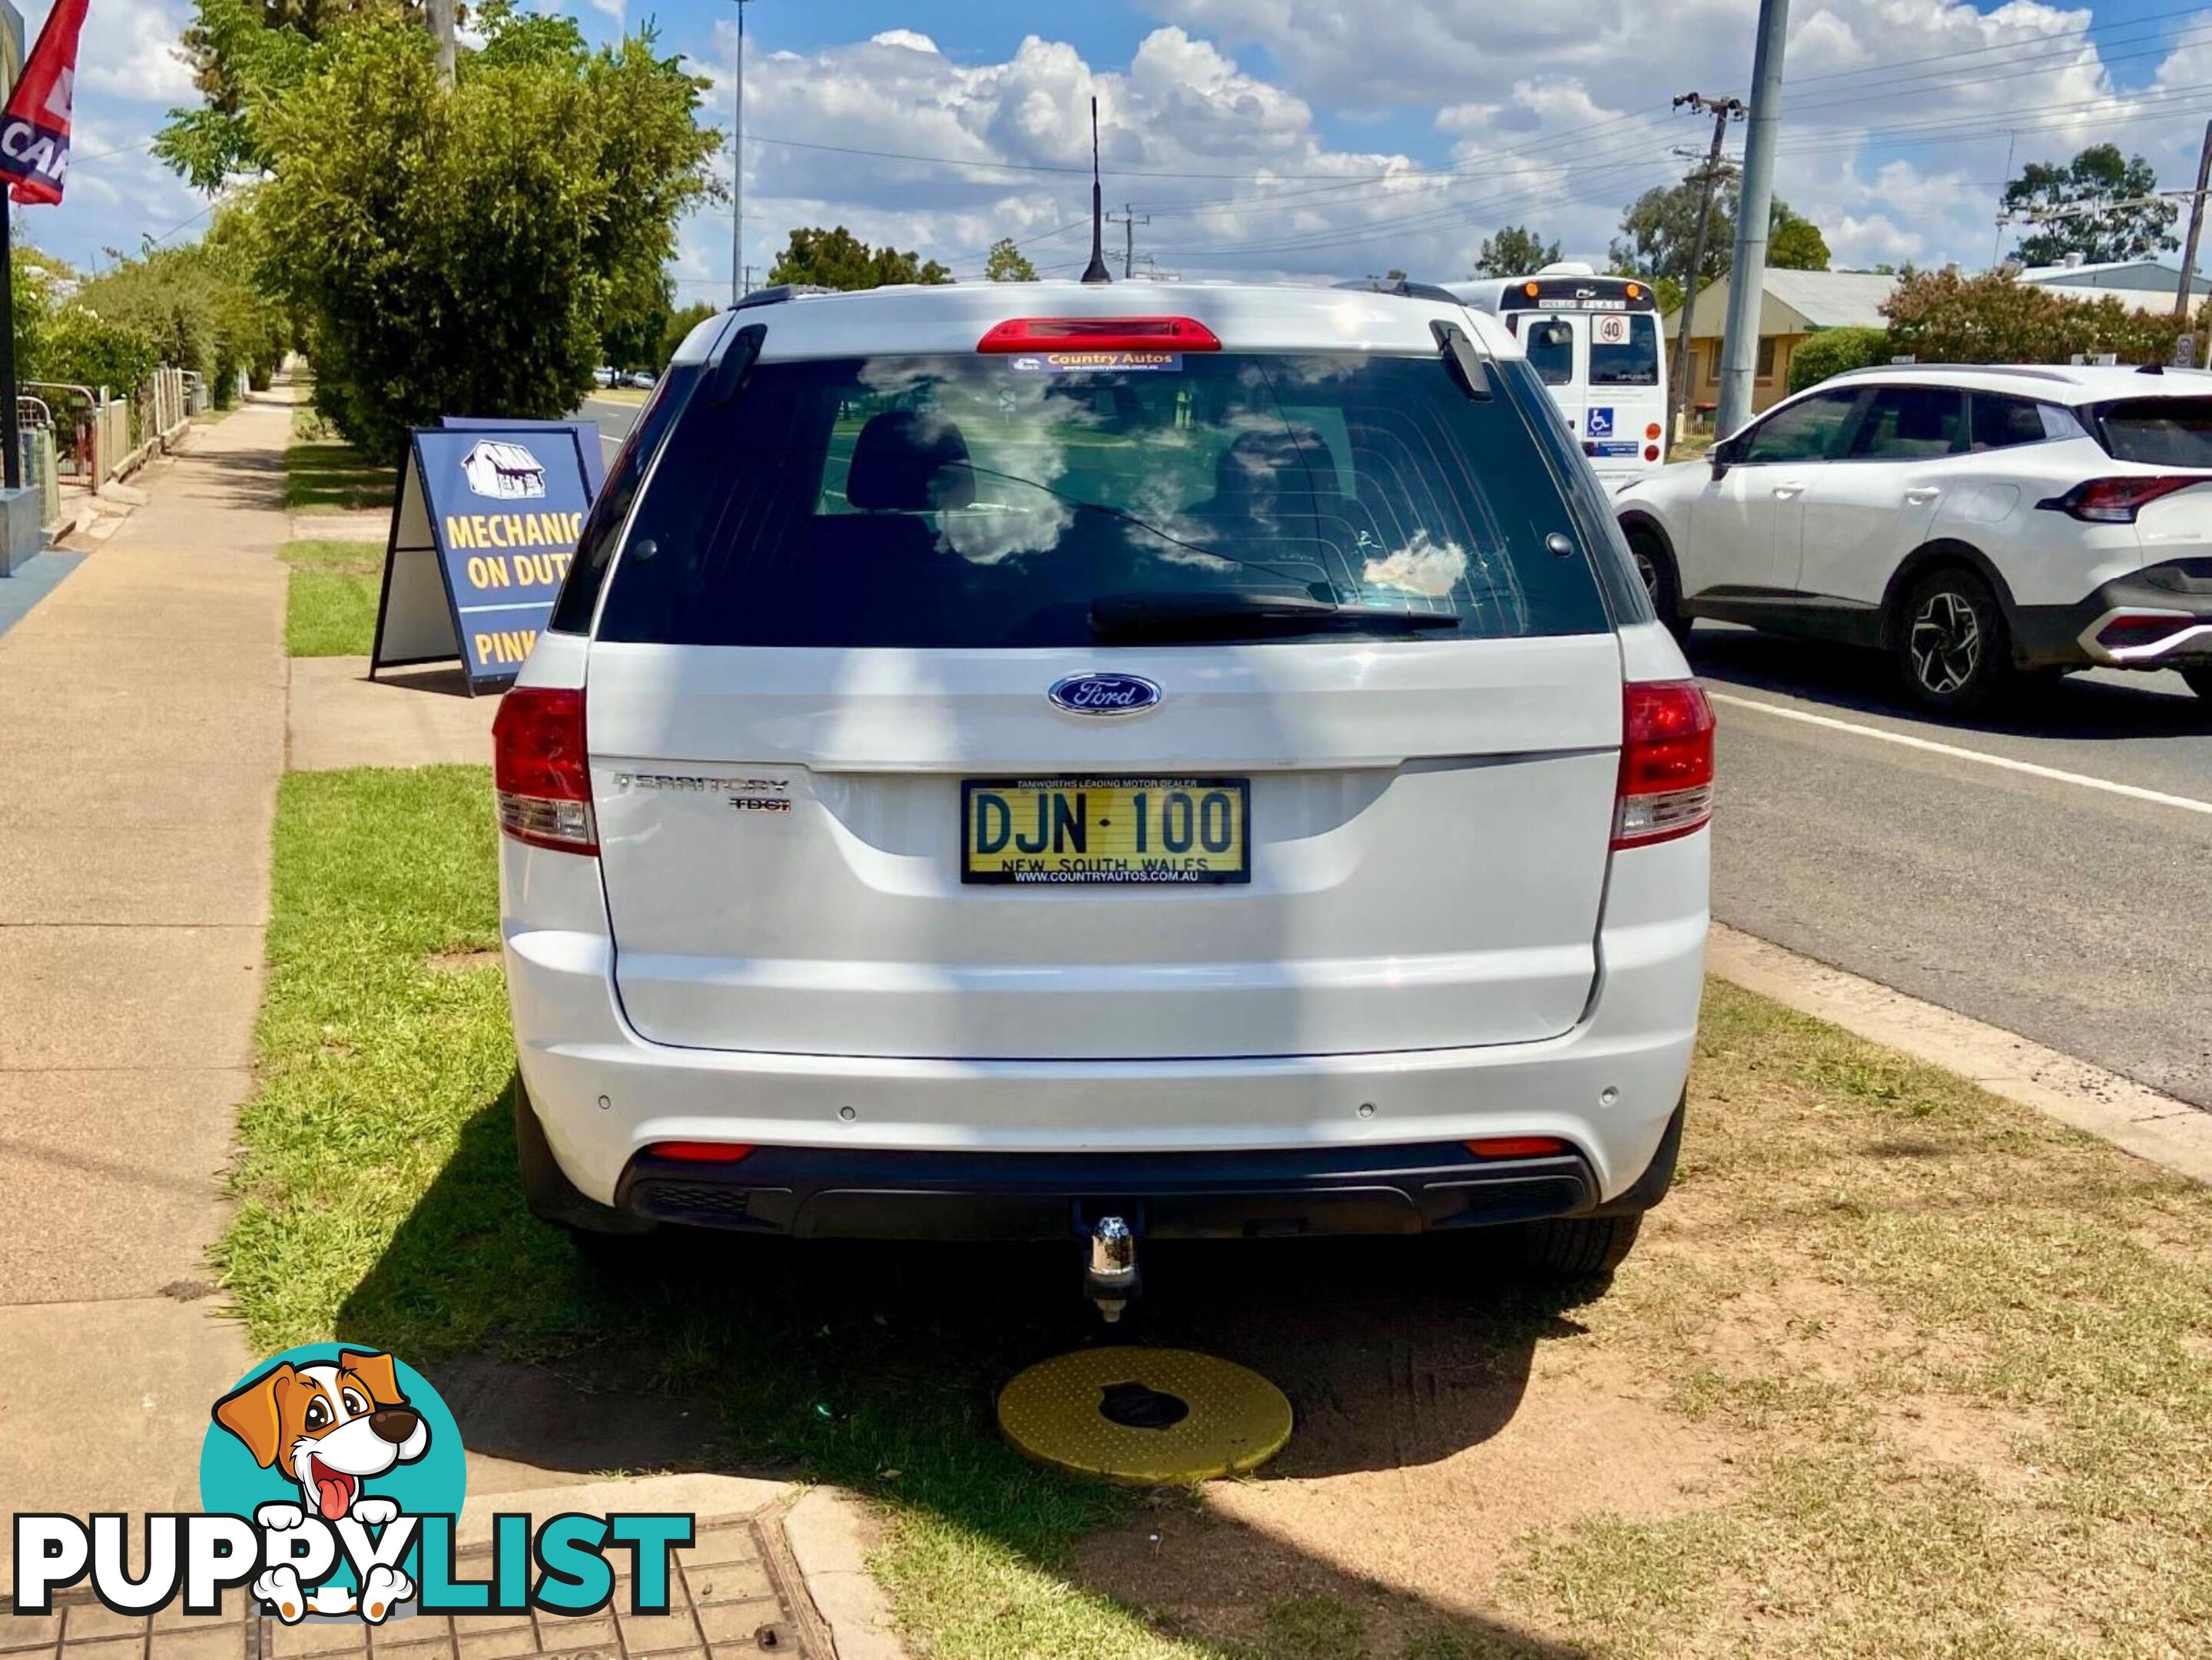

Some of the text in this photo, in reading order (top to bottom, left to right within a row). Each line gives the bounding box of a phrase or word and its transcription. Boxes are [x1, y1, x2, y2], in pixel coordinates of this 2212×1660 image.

[1604, 321, 1620, 337] 40
[1047, 353, 1172, 365] Country Autos
[467, 553, 573, 589] ON DUT
[1073, 681, 1136, 705] Ford
[613, 773, 790, 794] TERRITORY
[1123, 779, 1158, 788] MOTOR
[1160, 779, 1197, 788] DEALER
[1001, 858, 1209, 872] NEW SOUTH WALES
[1014, 872, 1199, 881] WWW.COUNTRYAUTOS.COM.AU
